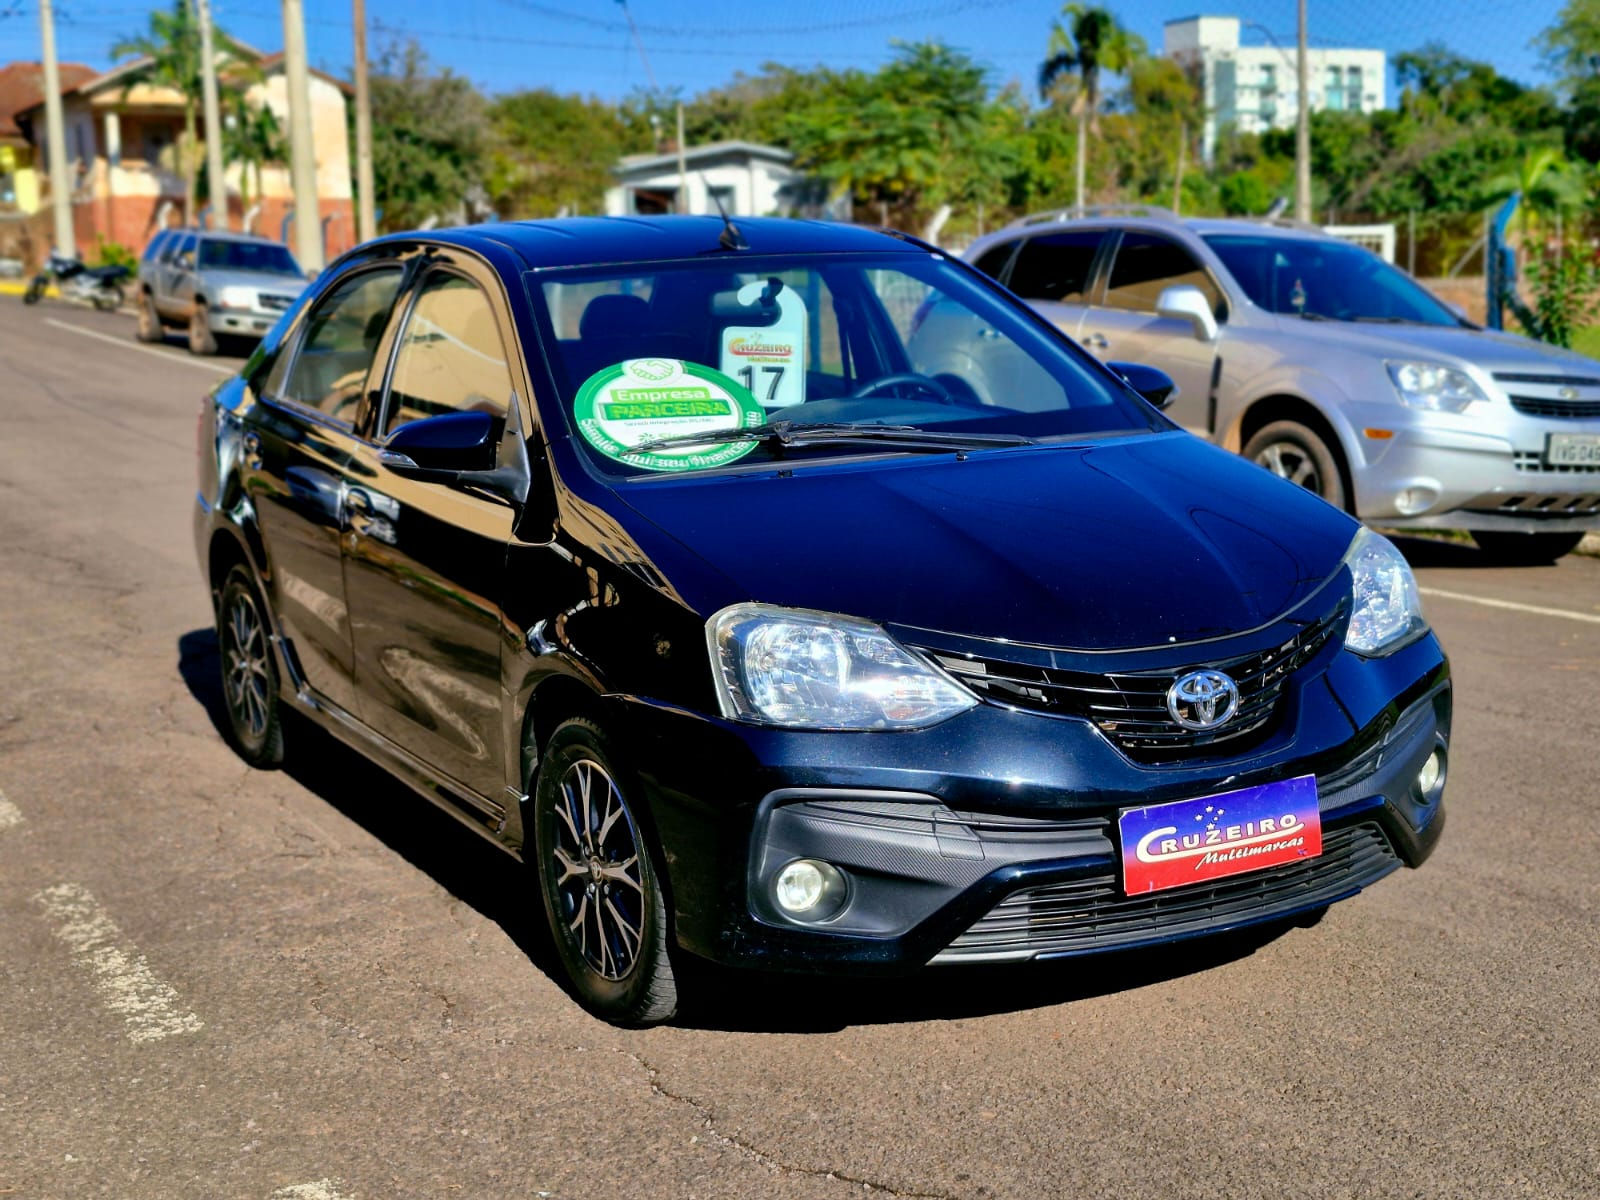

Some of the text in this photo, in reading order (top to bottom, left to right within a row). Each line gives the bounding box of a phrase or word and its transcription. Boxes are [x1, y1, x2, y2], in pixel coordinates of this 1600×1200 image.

[617, 389, 706, 402] Empresa
[738, 365, 785, 400] 17
[610, 402, 730, 418] PARCEIRA
[1135, 813, 1305, 863] CRUZEIRO
[1195, 836, 1305, 871] Multimarcas
